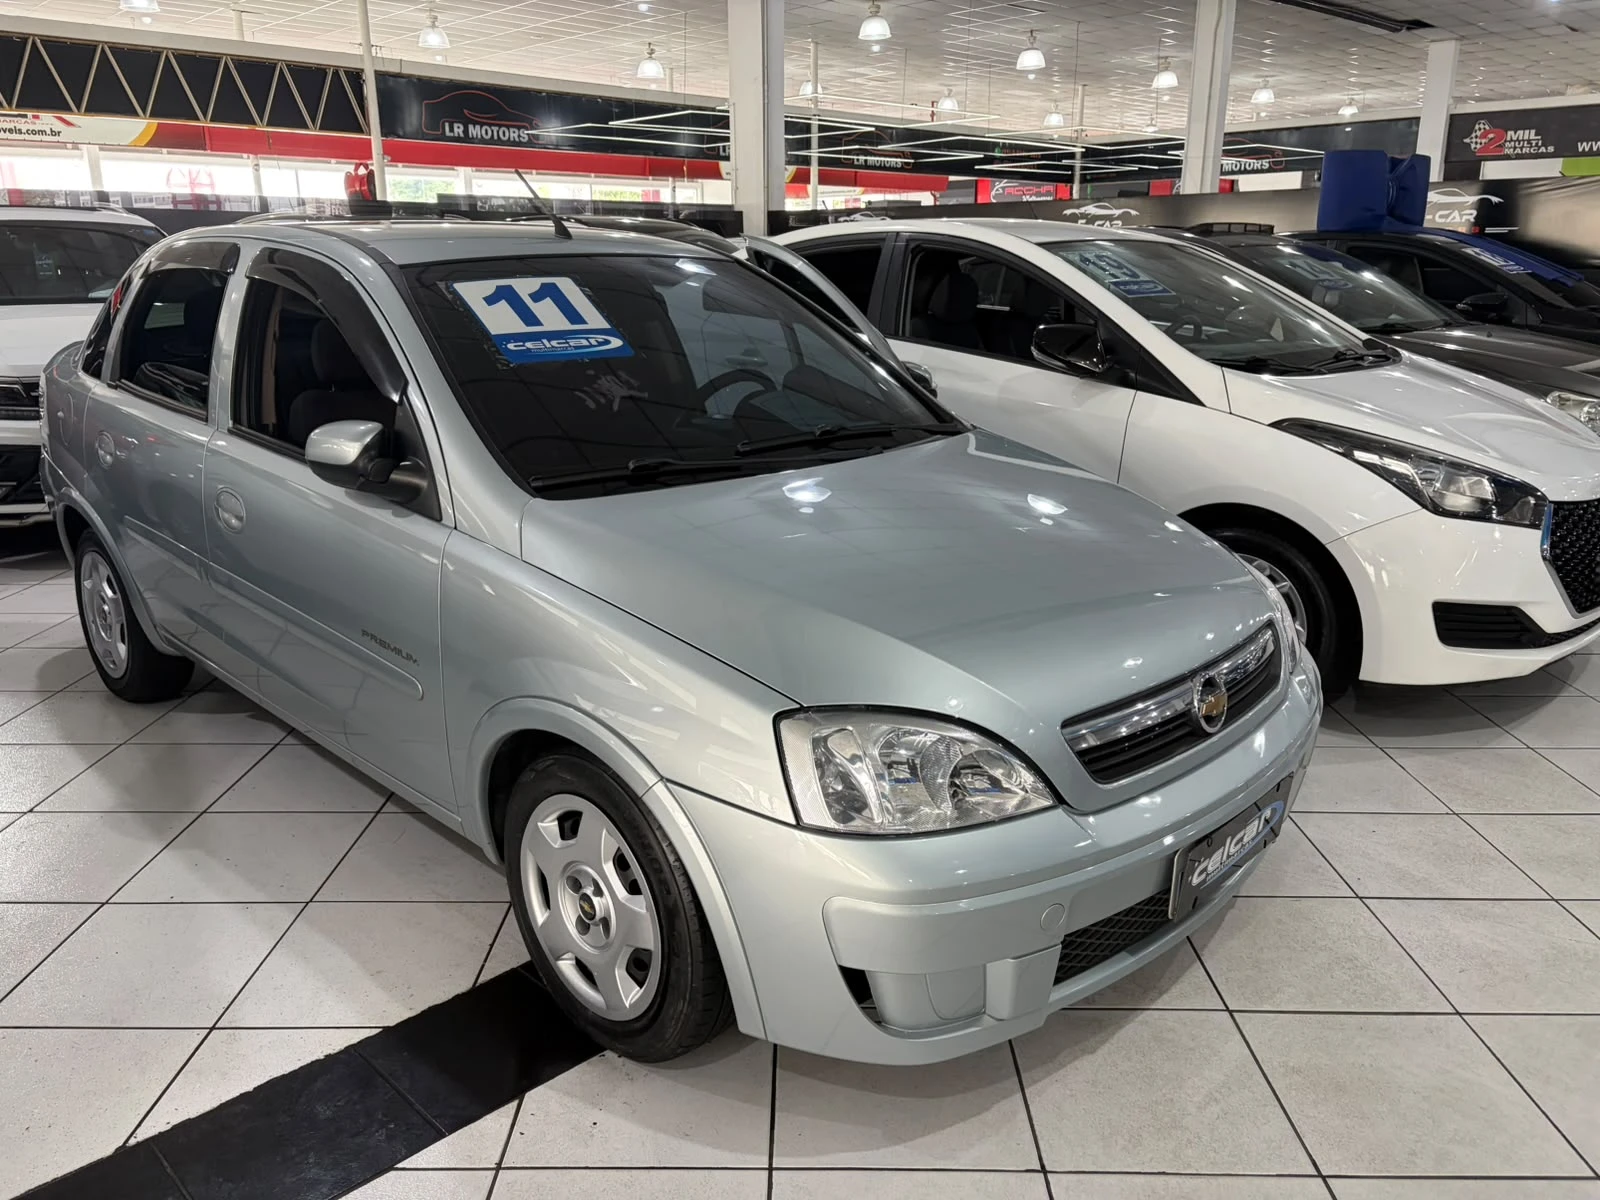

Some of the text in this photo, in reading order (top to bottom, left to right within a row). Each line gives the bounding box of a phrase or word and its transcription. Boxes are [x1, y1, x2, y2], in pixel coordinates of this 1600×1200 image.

[0, 118, 37, 126] ARCAS
[444, 122, 529, 142] LR MOTORS
[1506, 129, 1541, 141] MIL
[1475, 128, 1506, 155] 2
[1505, 140, 1542, 148] MULTI
[1505, 146, 1555, 154] MARCAS
[867, 156, 902, 168] MOTORS
[1222, 160, 1270, 172] MOTORS
[482, 282, 588, 327] 11
[507, 338, 605, 350] celcar
[361, 629, 420, 667] PREMIUM
[1191, 807, 1272, 886] celcar
